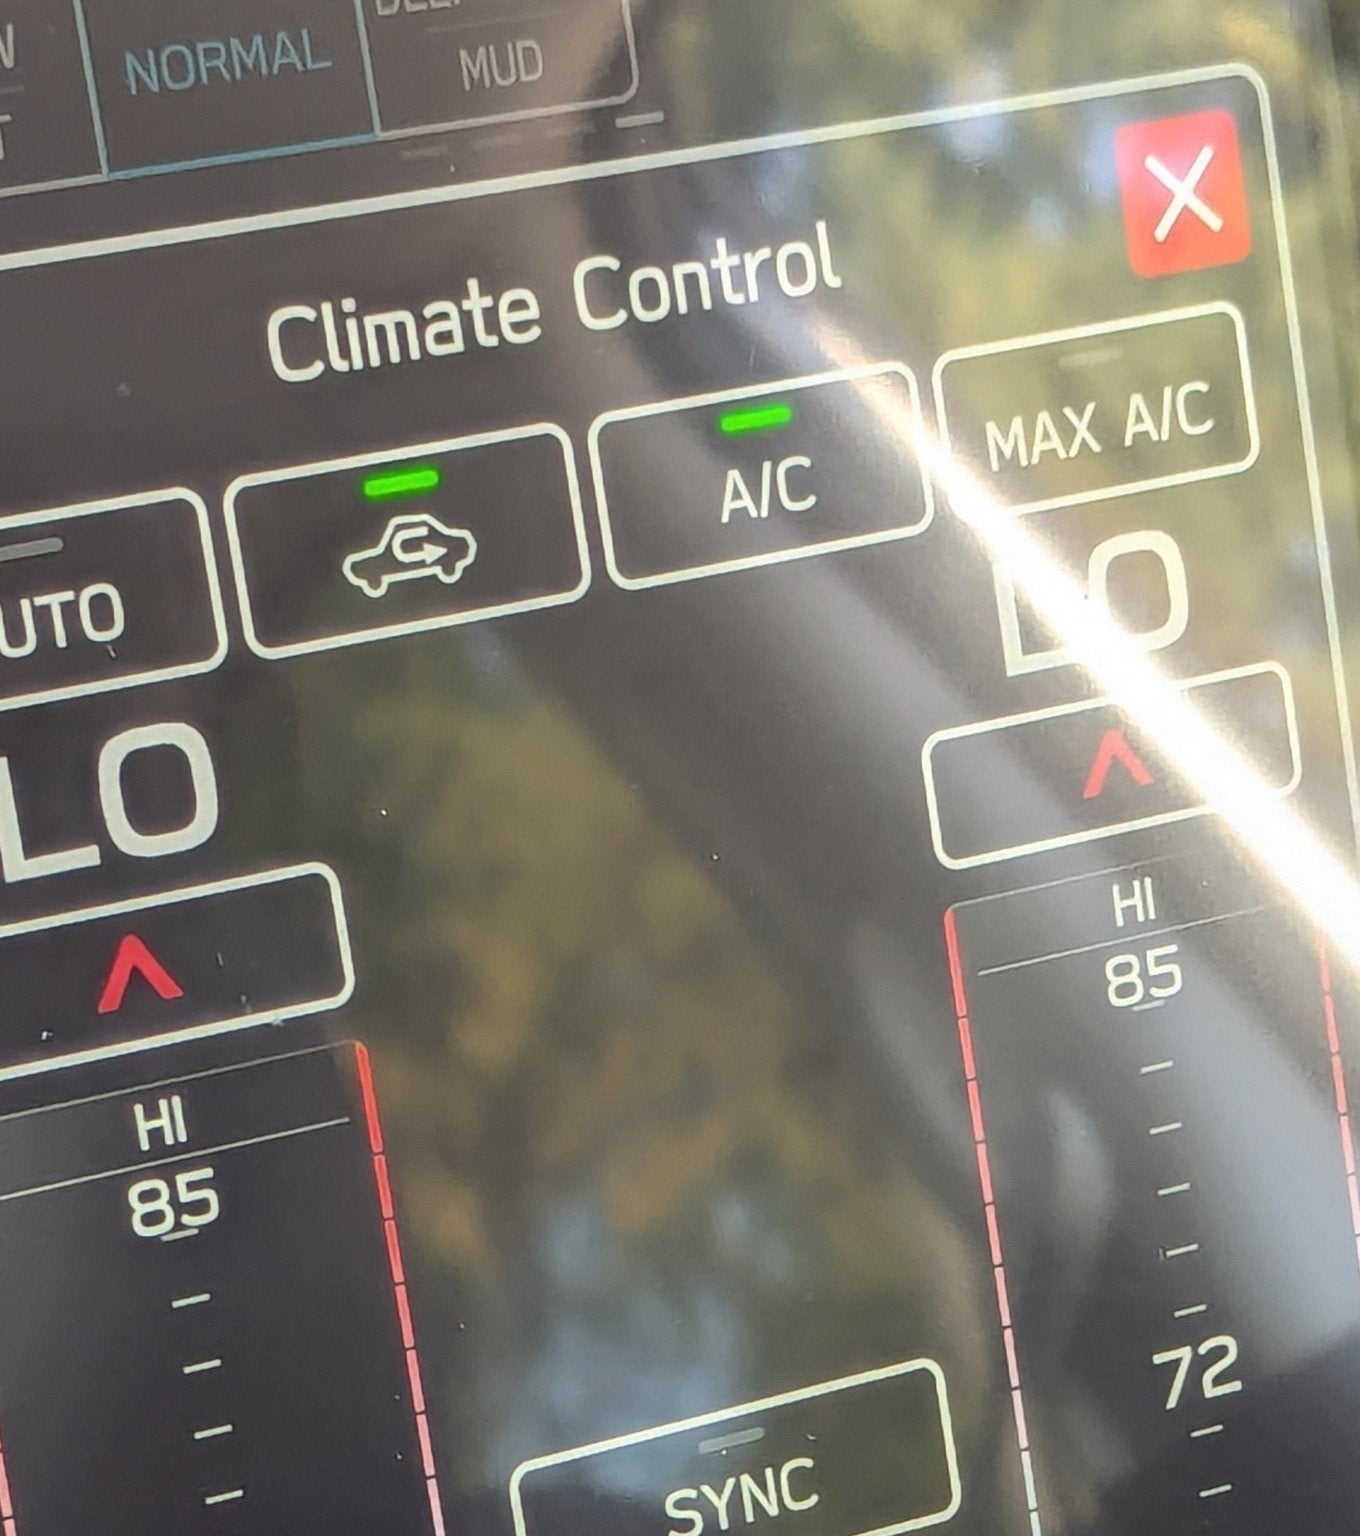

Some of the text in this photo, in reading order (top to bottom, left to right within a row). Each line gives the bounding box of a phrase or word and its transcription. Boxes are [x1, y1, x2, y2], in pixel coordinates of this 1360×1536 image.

[124, 28, 332, 96] NORMAL
[458, 39, 545, 91] MUD
[266, 220, 843, 384] Climate Control
[985, 378, 1217, 472] MAX A/C
[718, 454, 818, 524] A/C
[992, 528, 1190, 676] LO
[1111, 875, 1157, 928] HI
[1104, 944, 1184, 1010] 85
[132, 1094, 187, 1152] HI
[126, 1166, 221, 1239] 85
[1151, 1335, 1243, 1411] 72
